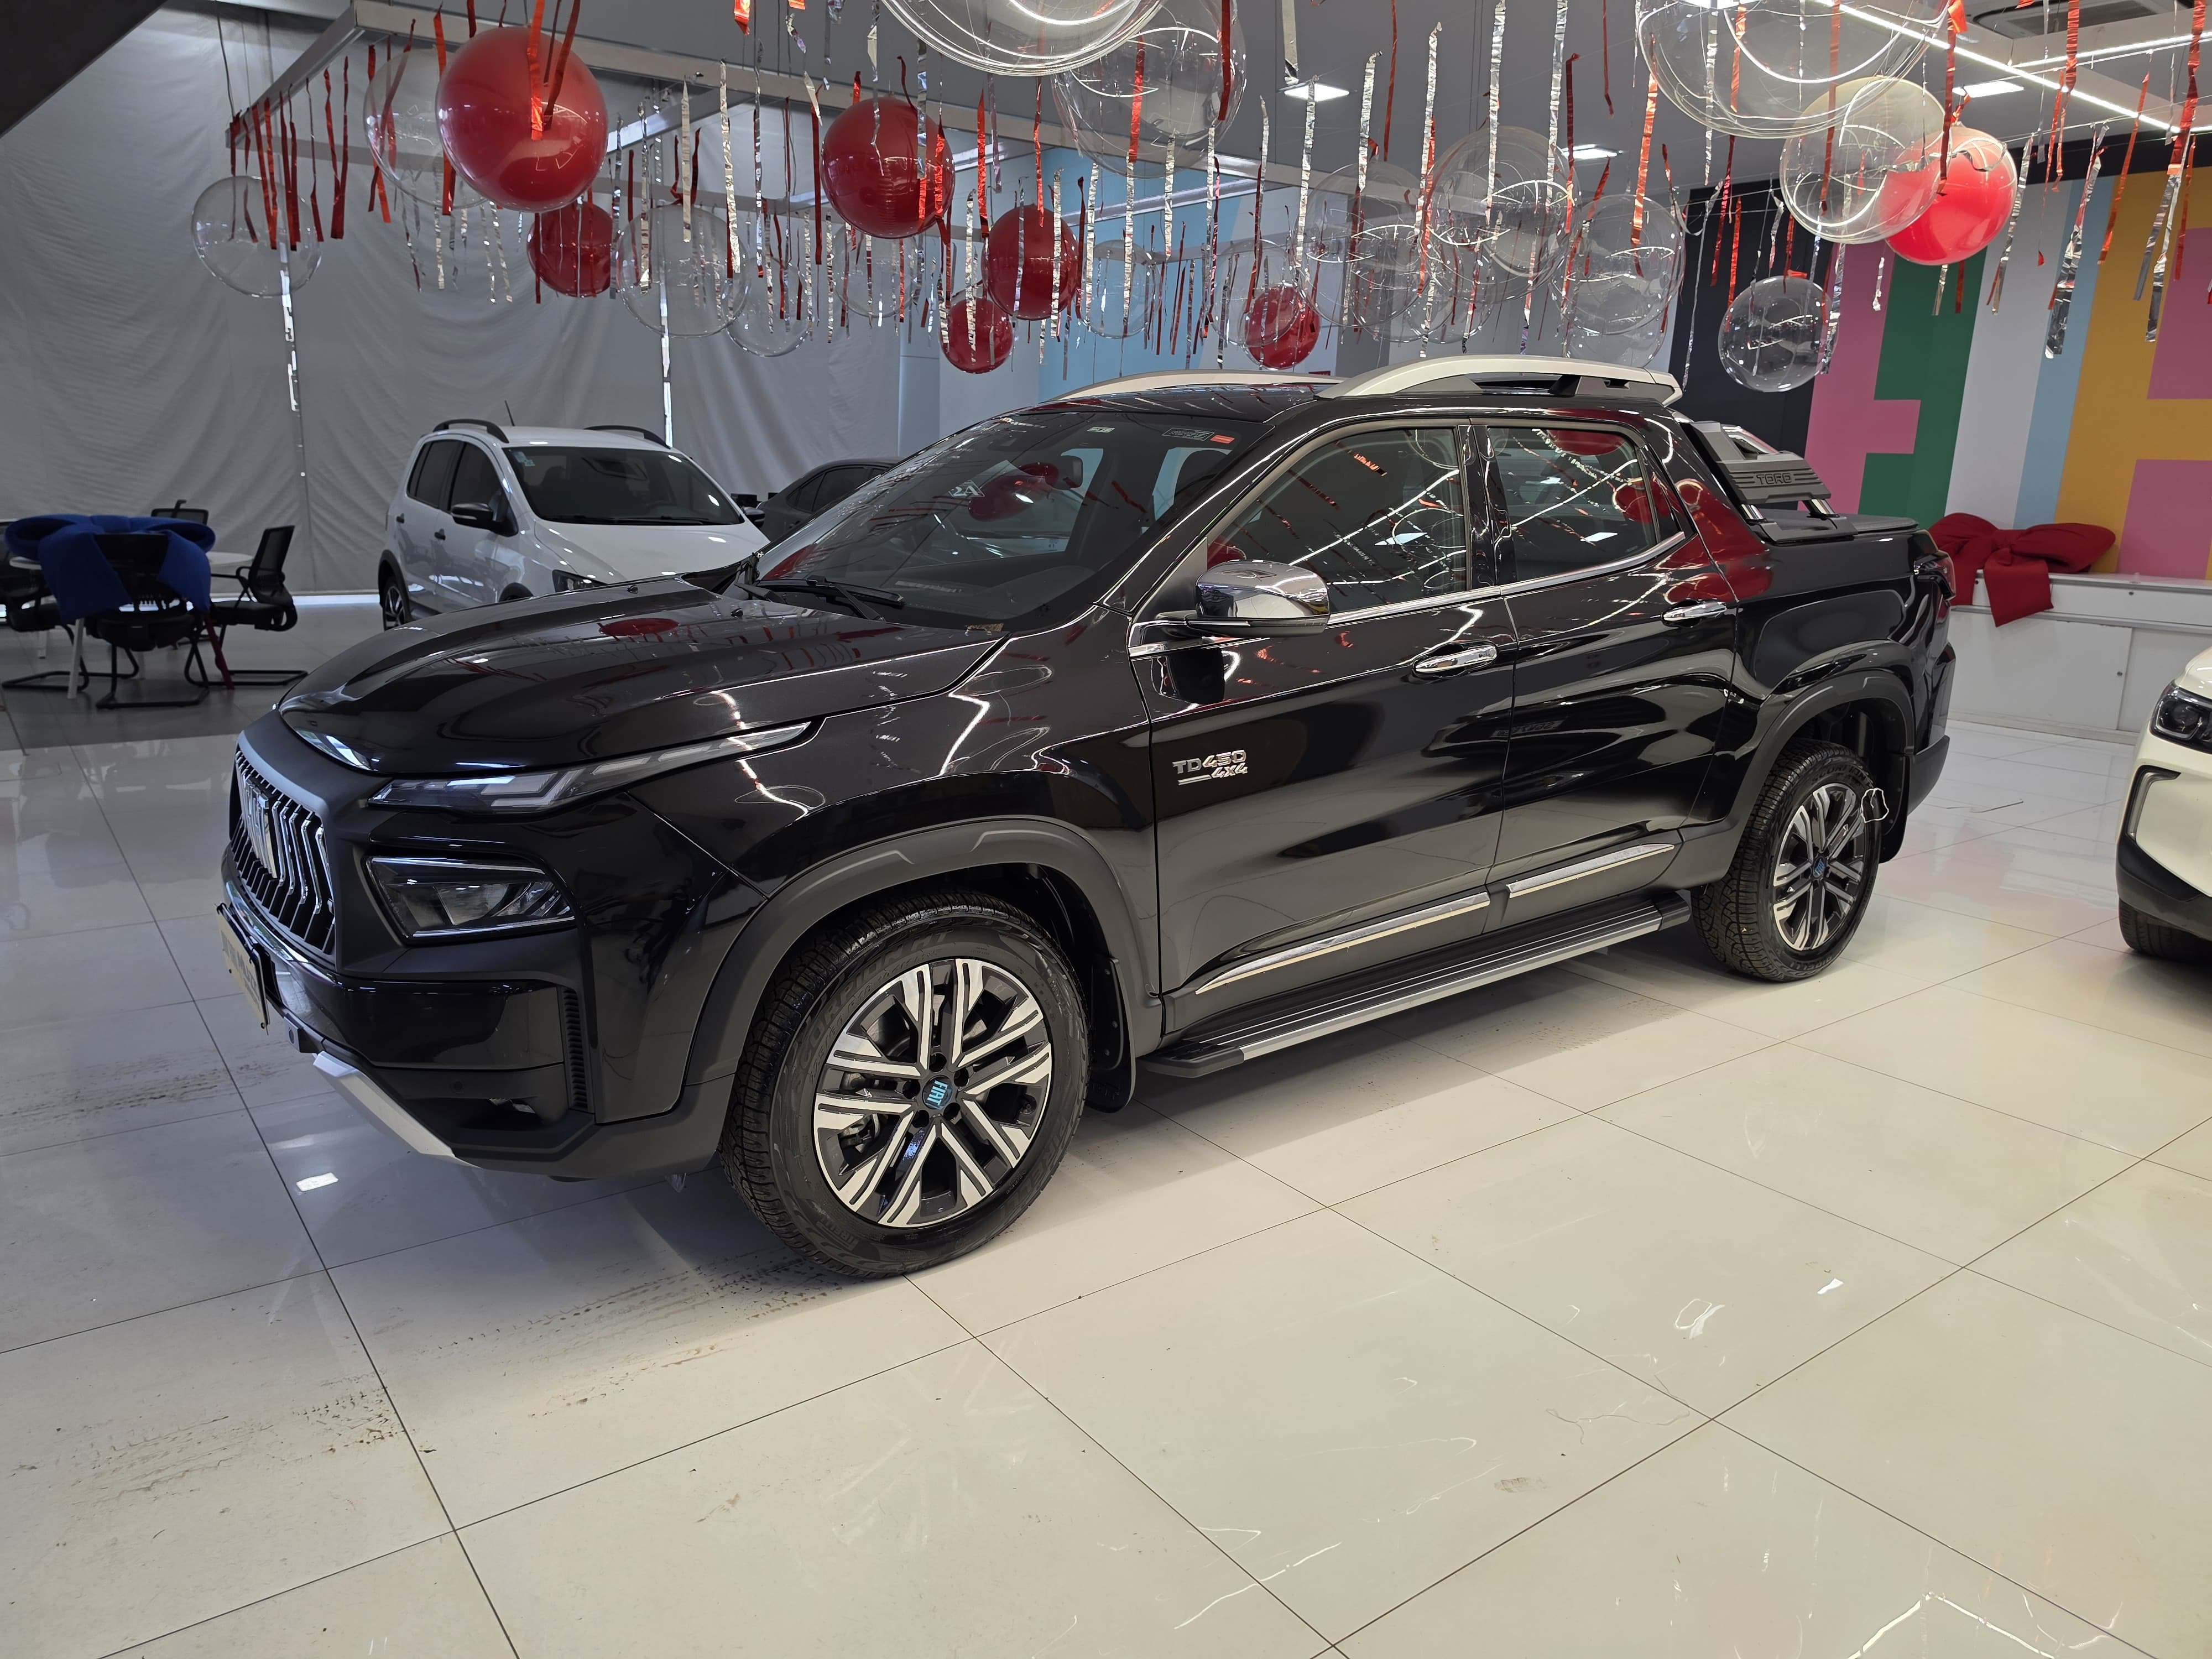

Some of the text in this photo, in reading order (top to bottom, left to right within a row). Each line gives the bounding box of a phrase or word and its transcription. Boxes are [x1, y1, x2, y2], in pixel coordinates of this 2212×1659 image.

[1756, 473, 1792, 485] TORO
[1172, 749, 1247, 774] TD450
[927, 1080, 948, 1106] FIAT
